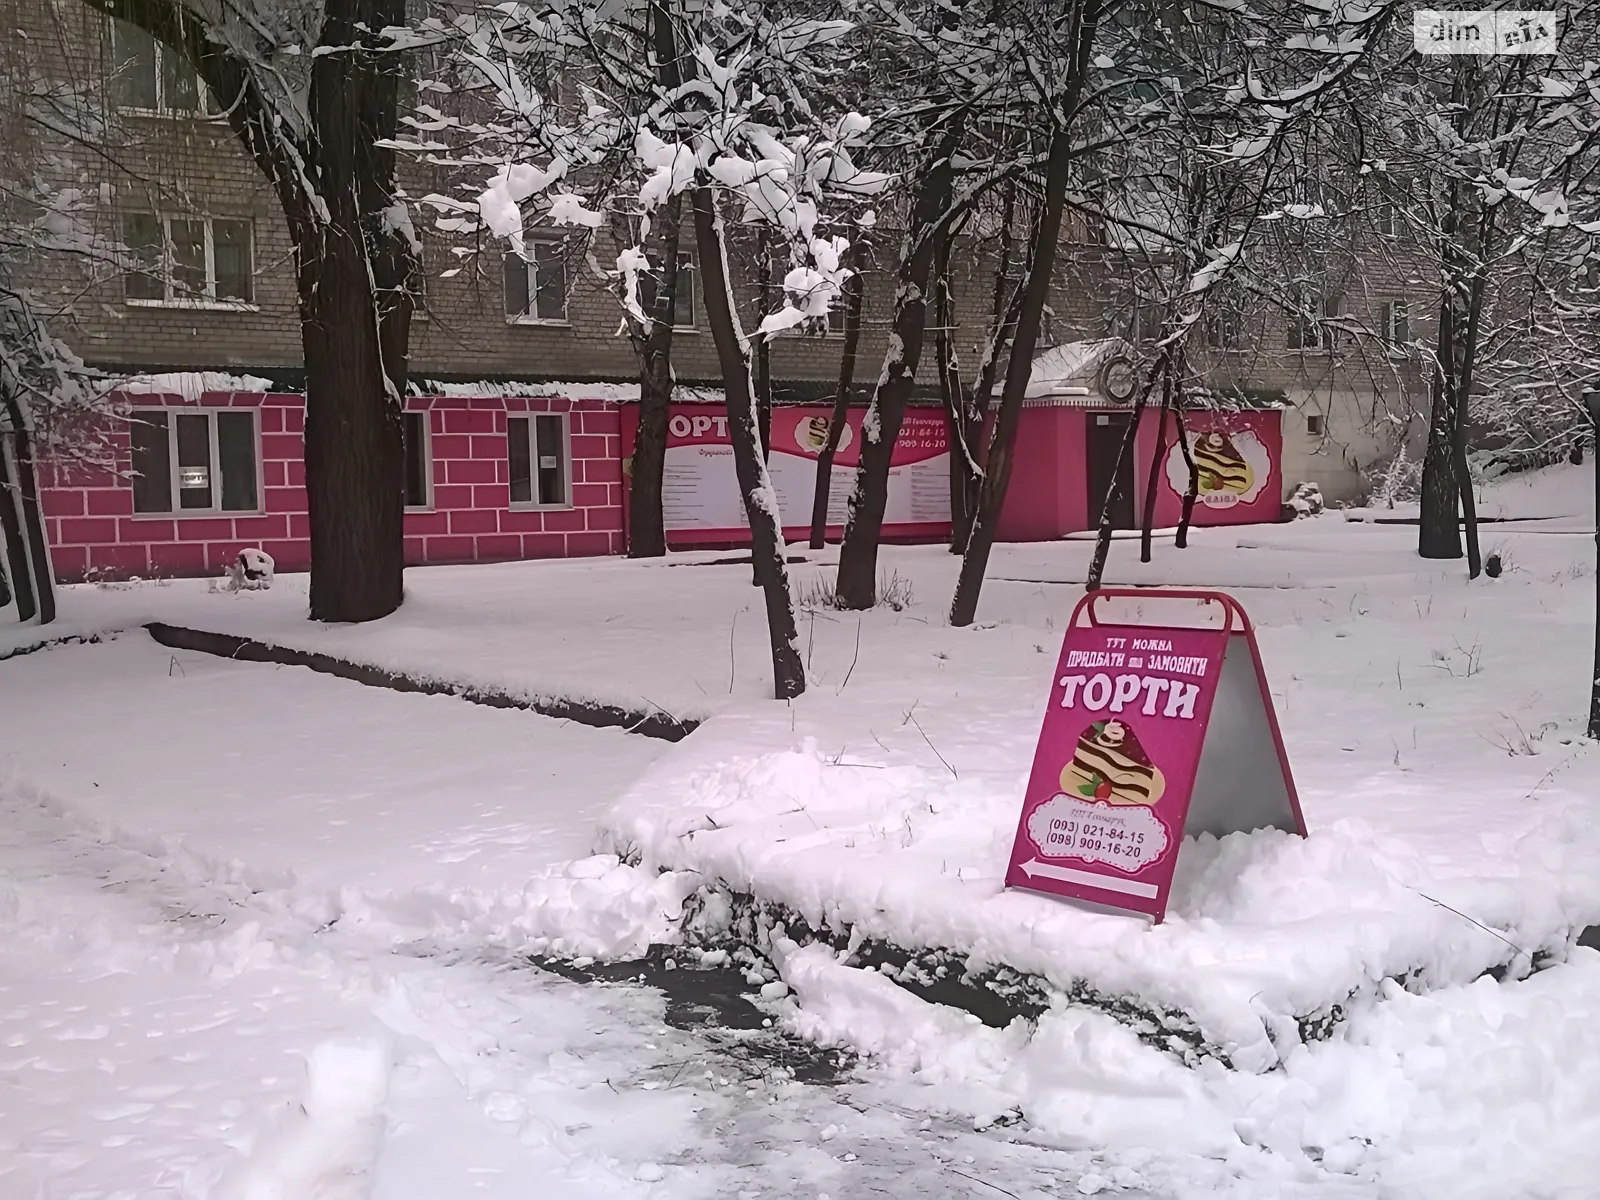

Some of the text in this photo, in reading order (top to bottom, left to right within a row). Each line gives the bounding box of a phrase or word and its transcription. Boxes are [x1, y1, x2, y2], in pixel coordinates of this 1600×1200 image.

[1106, 637, 1173, 651] ТУТ МОЖНА
[1066, 650, 1126, 668] ПРИДБАТИ
[1147, 654, 1208, 677] ЗАМОВИТИ
[1059, 672, 1201, 719] ТОРТИ
[1049, 818, 1145, 844] (093) 021-84-15
[1046, 832, 1142, 858] (098) 909-16-20
